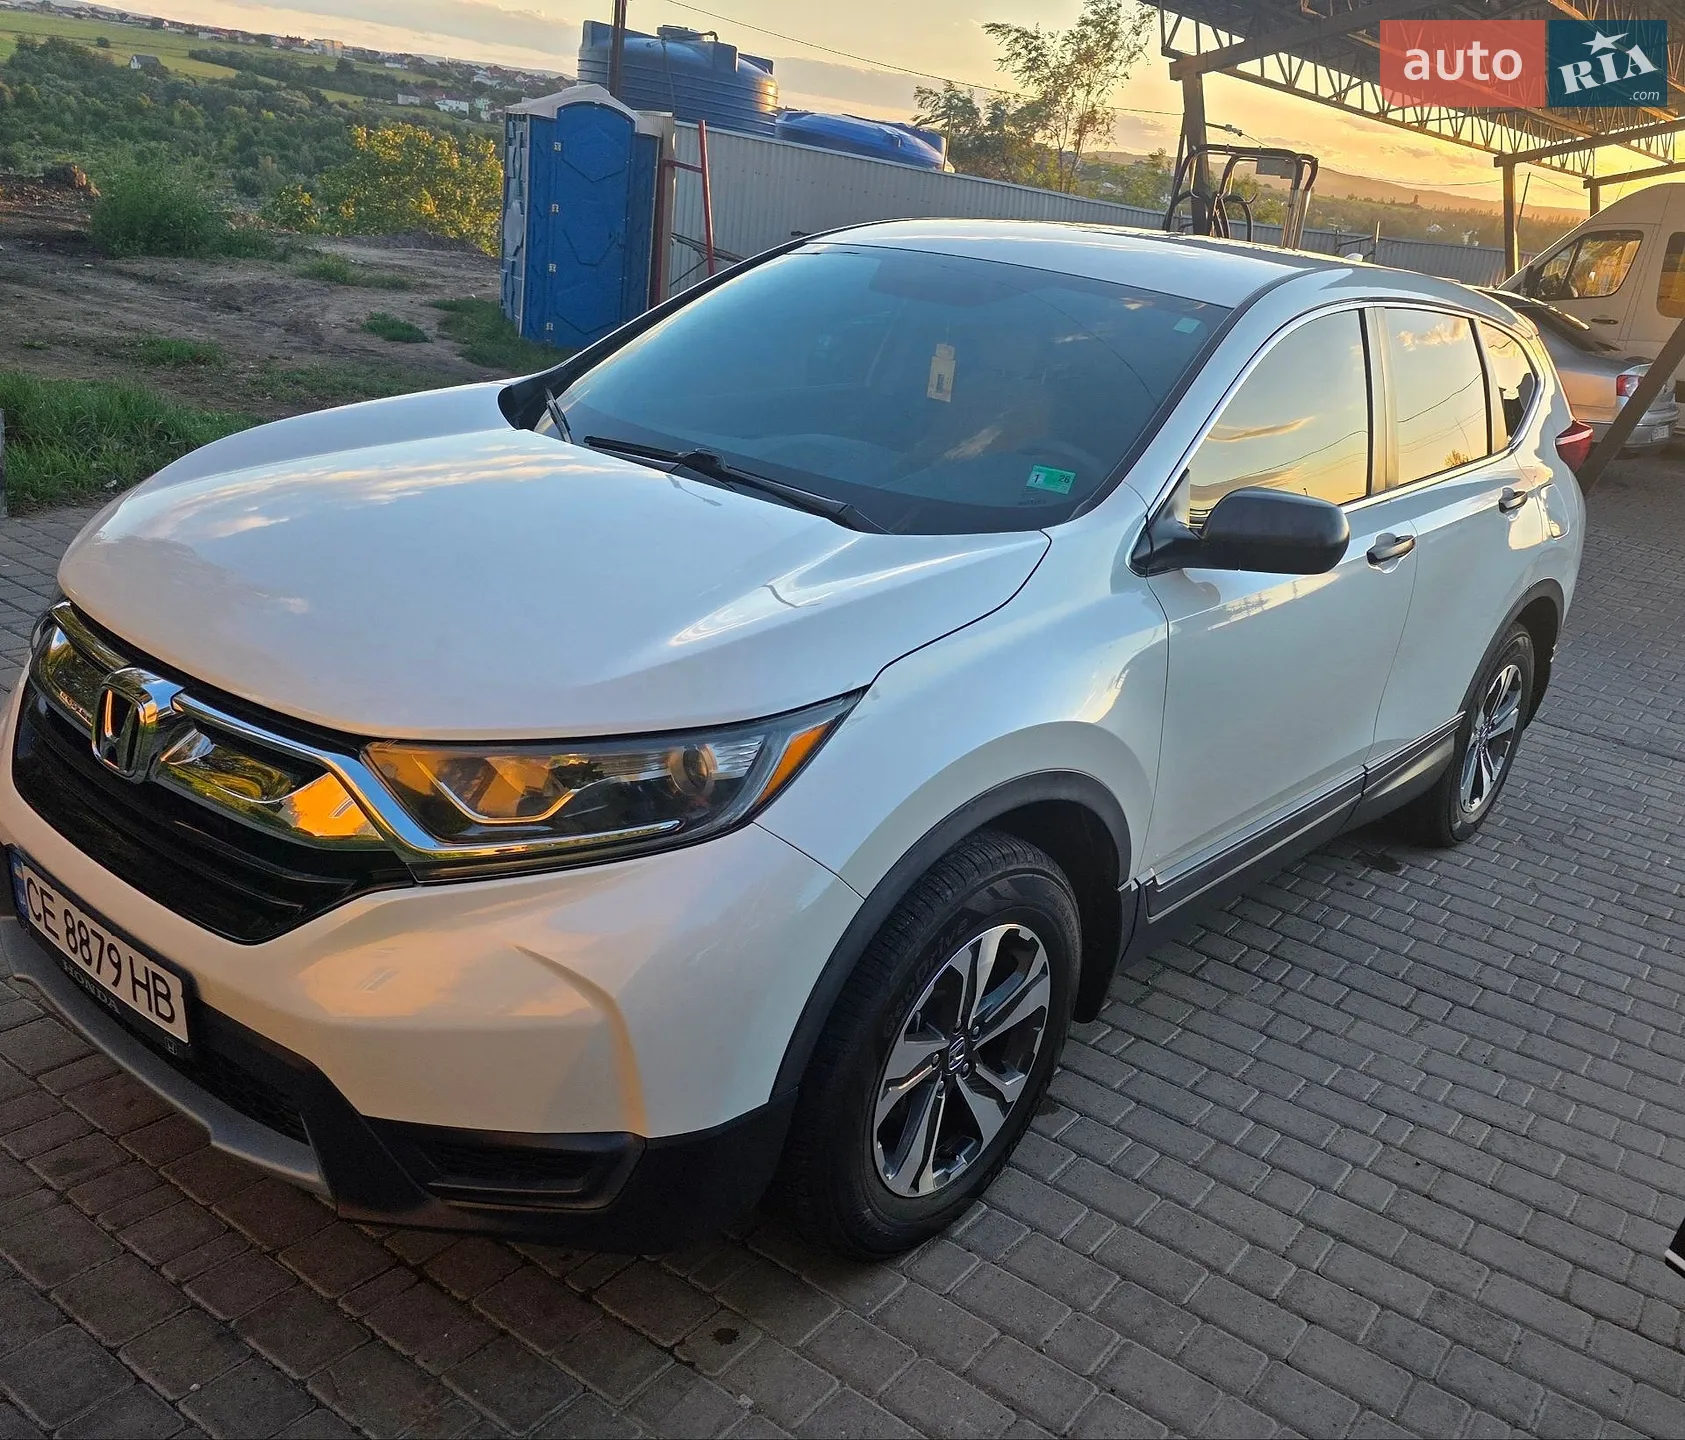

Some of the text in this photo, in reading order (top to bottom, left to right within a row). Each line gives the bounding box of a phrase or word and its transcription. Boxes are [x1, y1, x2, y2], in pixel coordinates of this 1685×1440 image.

[1033, 474, 1071, 484] 1 26
[26, 876, 176, 1024] CE 8879 HB
[61, 958, 121, 1015] HONDA
